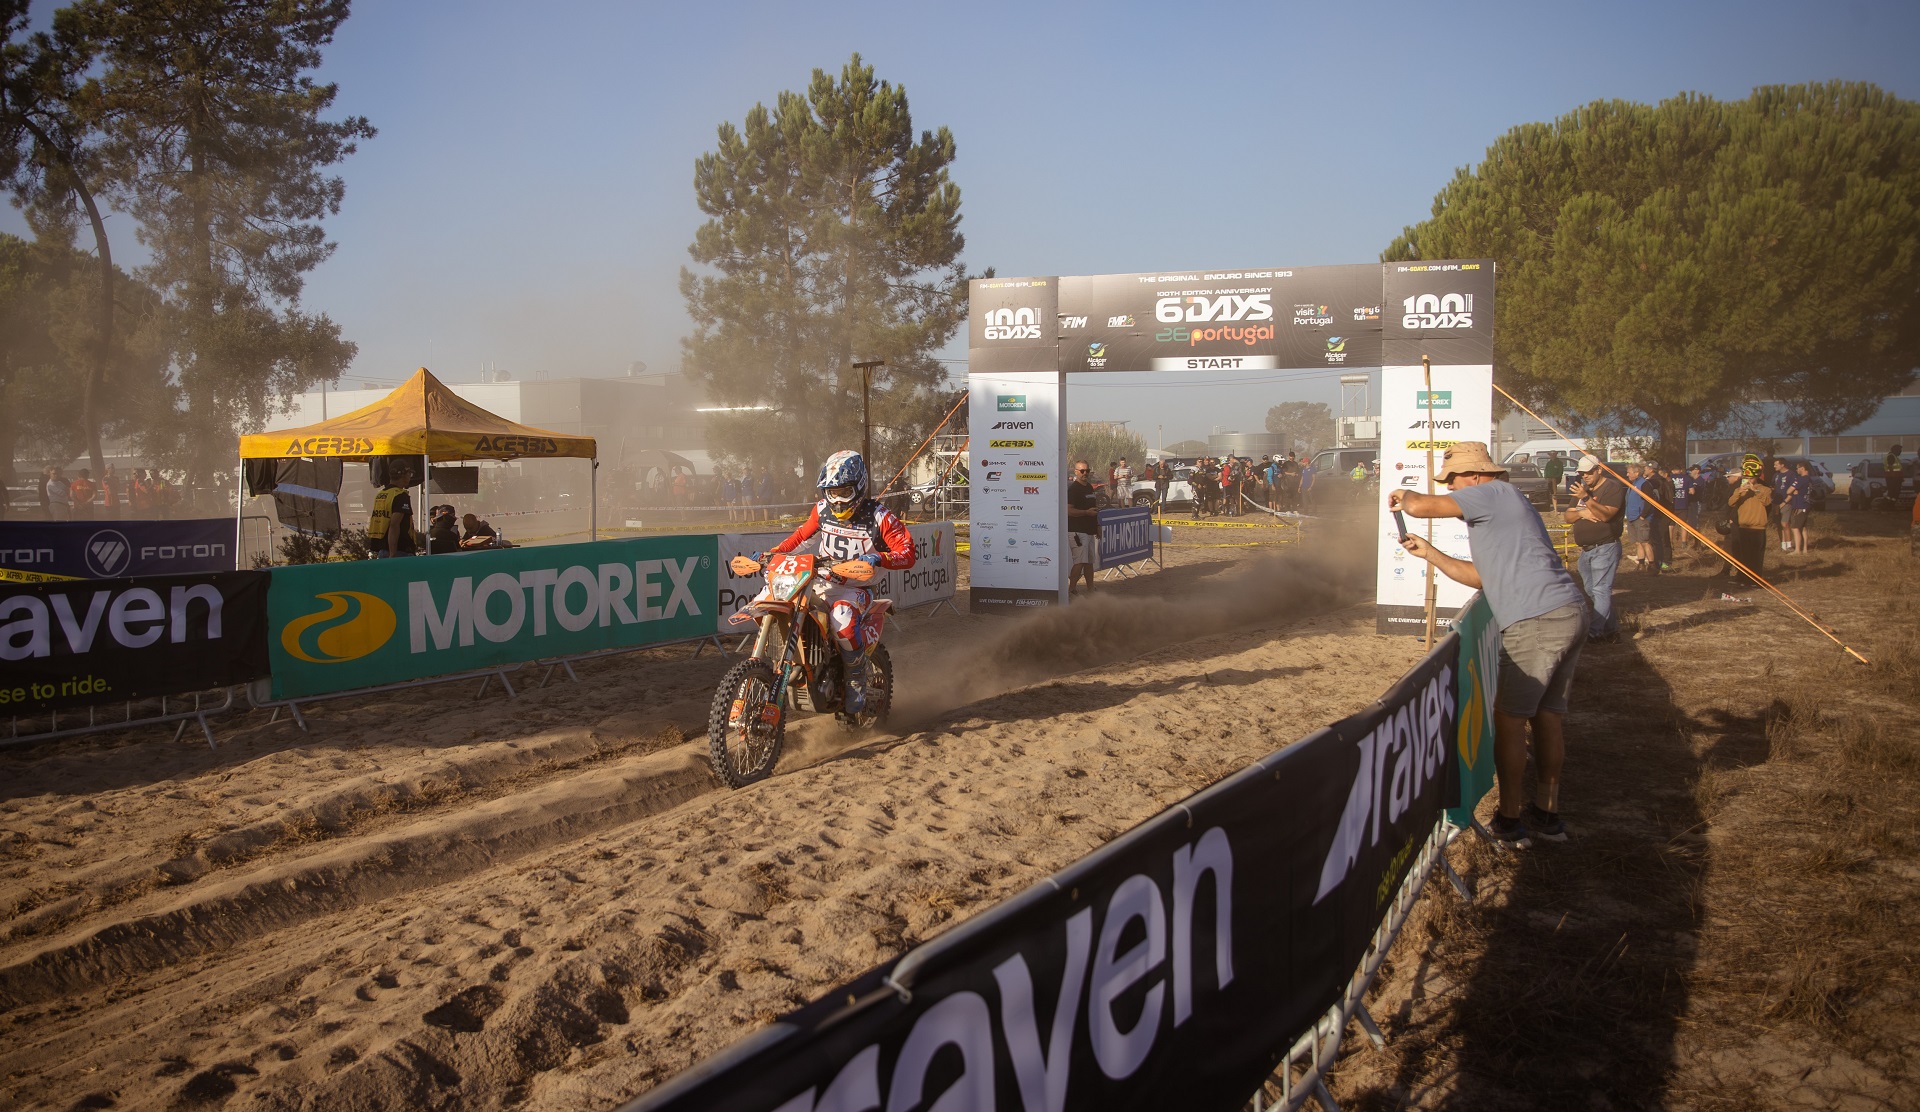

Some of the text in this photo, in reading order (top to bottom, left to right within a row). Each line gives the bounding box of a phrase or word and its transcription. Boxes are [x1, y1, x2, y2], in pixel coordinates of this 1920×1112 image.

[1158, 274, 1200, 282] ORIGINAL
[1204, 272, 1243, 280] ENDURO
[1244, 271, 1272, 279] SINCE
[1296, 308, 1314, 316] visit
[1061, 316, 1088, 328] FIM
[1294, 317, 1333, 326] Portugal
[1187, 358, 1243, 368] START
[1002, 422, 1034, 430] raven
[286, 437, 374, 455] ACERBIS
[475, 435, 558, 454] ACERBIS
[1024, 486, 1040, 494] RK
[1102, 518, 1149, 554] FIM-MOTO.TV
[140, 544, 226, 560] FOTON
[774, 560, 798, 575] 43
[904, 561, 950, 592] Portugal
[866, 626, 880, 644] 43
[31, 683, 56, 700] to
[62, 675, 112, 696] ride.
